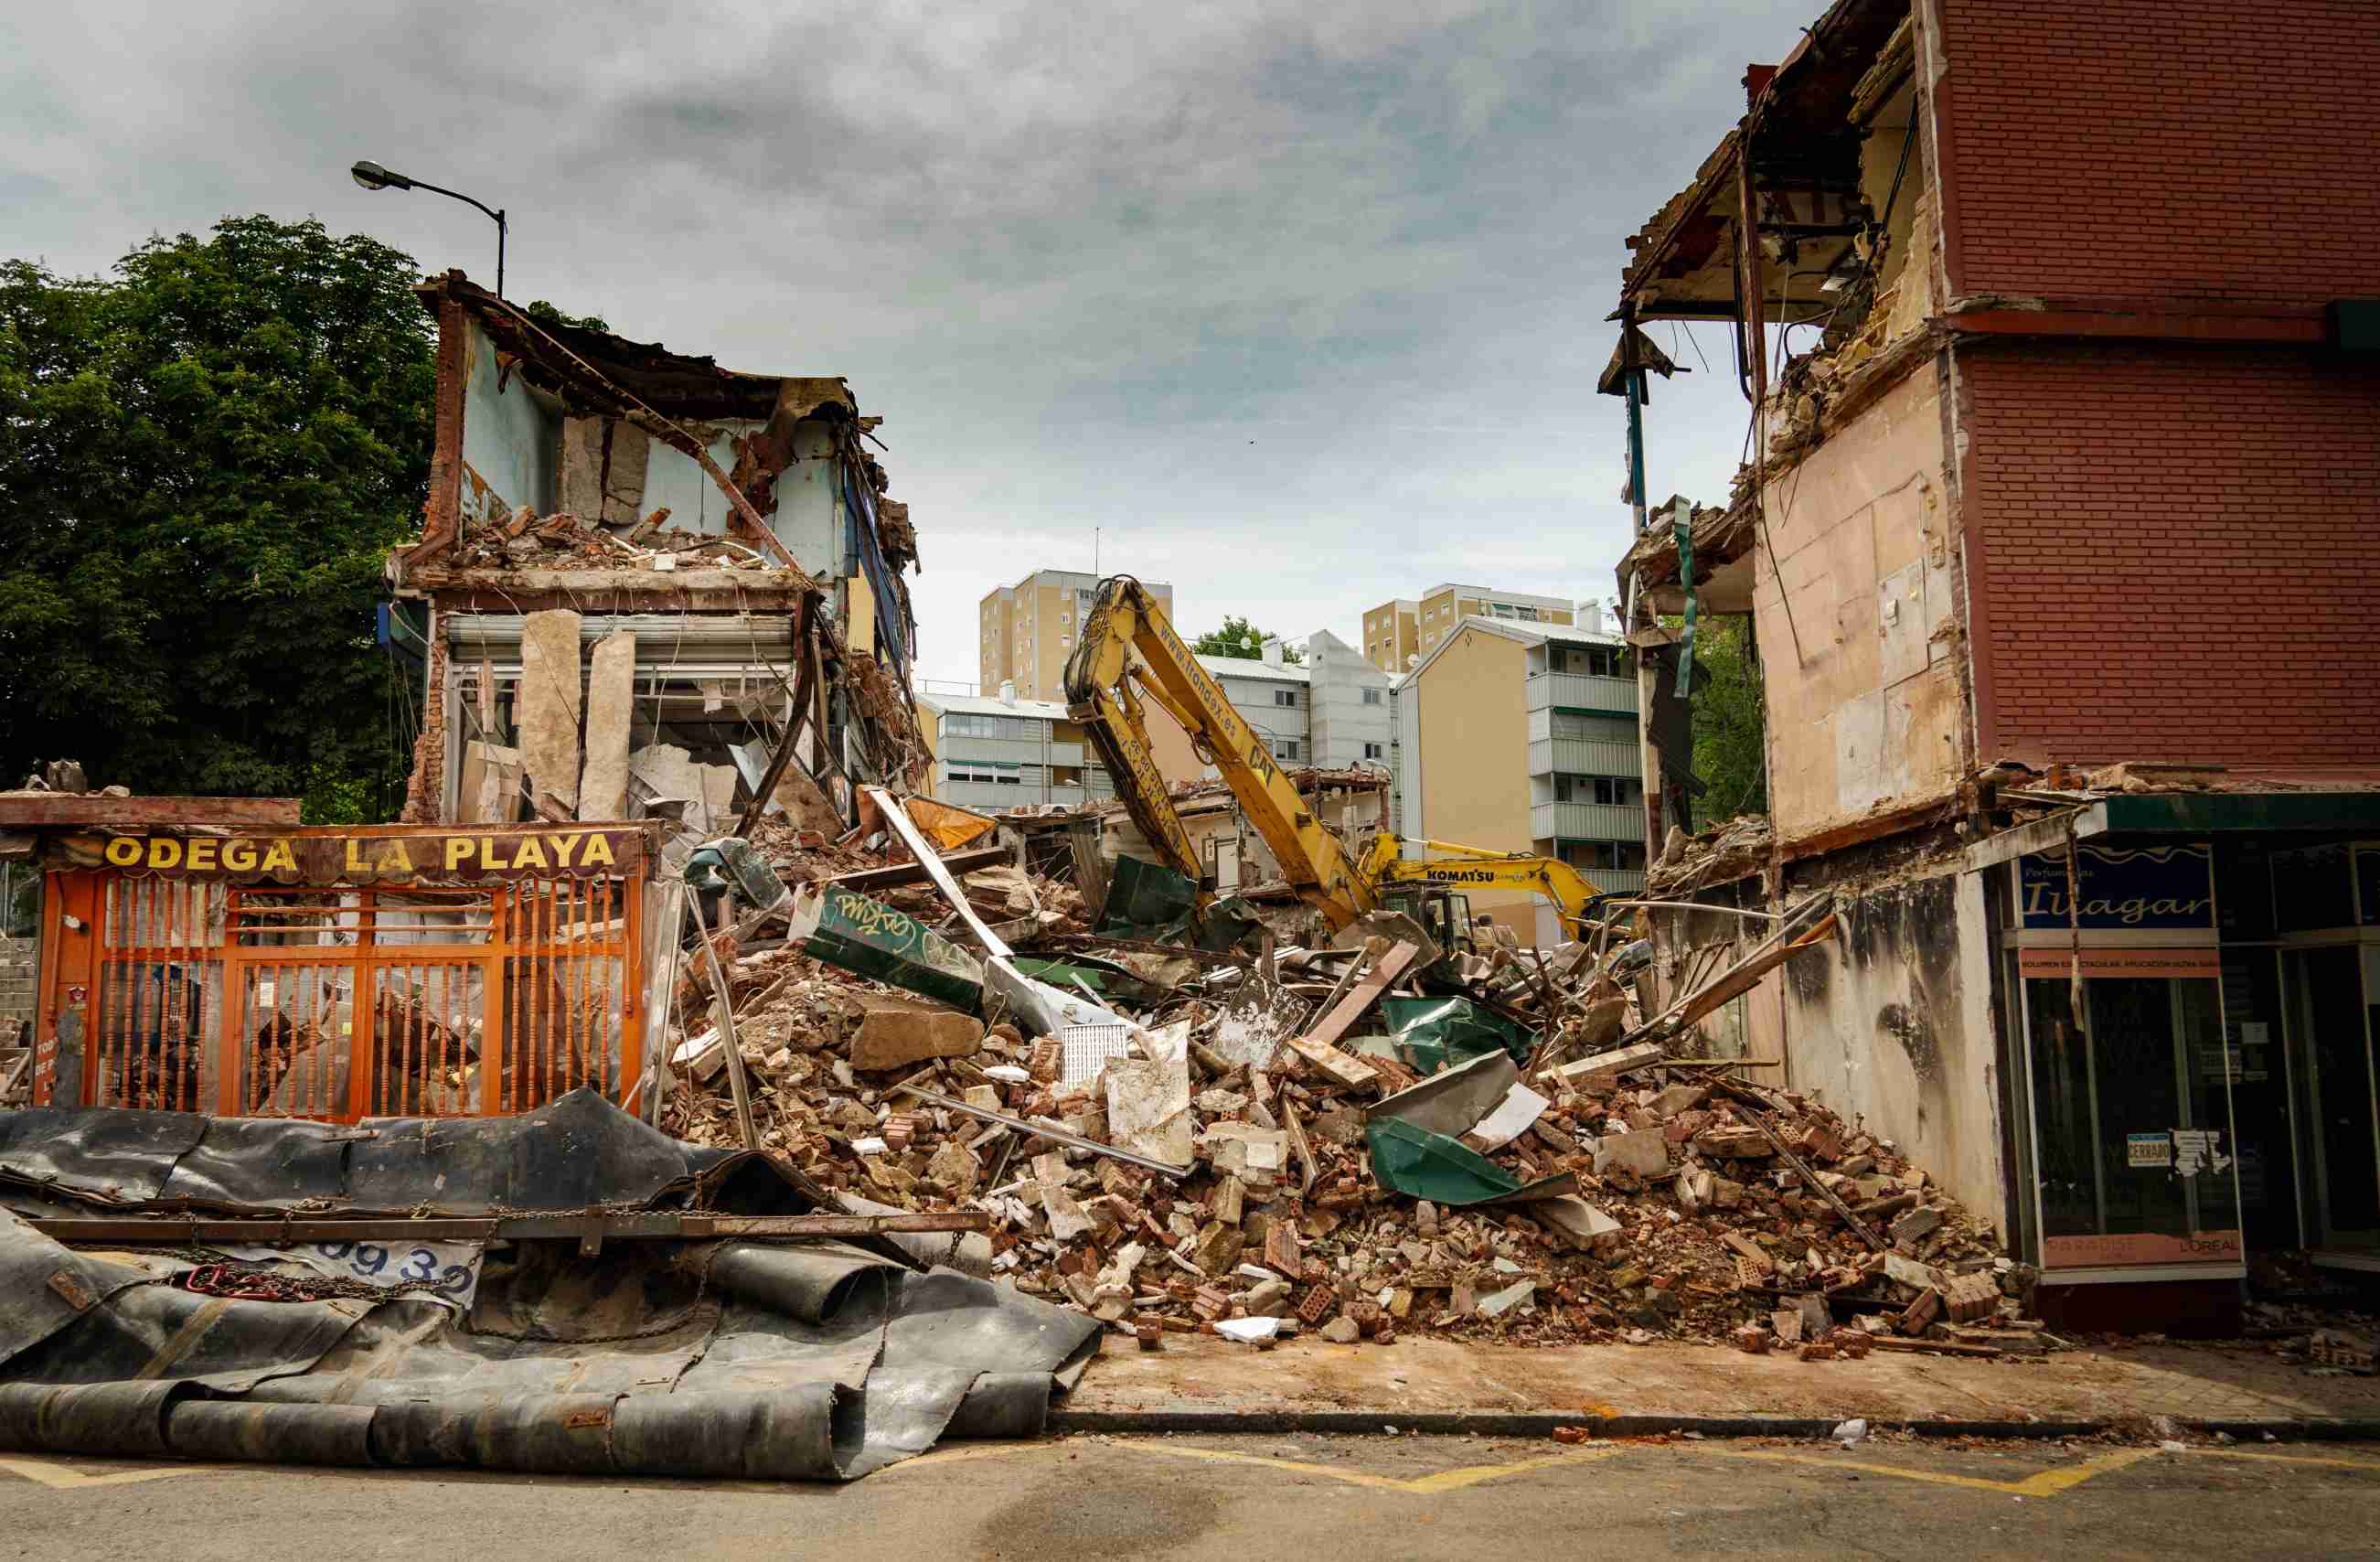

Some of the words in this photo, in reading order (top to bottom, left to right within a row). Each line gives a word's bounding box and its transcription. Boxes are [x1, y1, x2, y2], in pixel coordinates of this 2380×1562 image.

[1249, 745, 1275, 786] CAT
[105, 837, 299, 872] ODEGA
[345, 839, 414, 872] LA
[444, 833, 616, 872] PLAYA
[1426, 869, 1495, 883] KOMATSU
[2129, 1143, 2169, 1158] CERRADO
